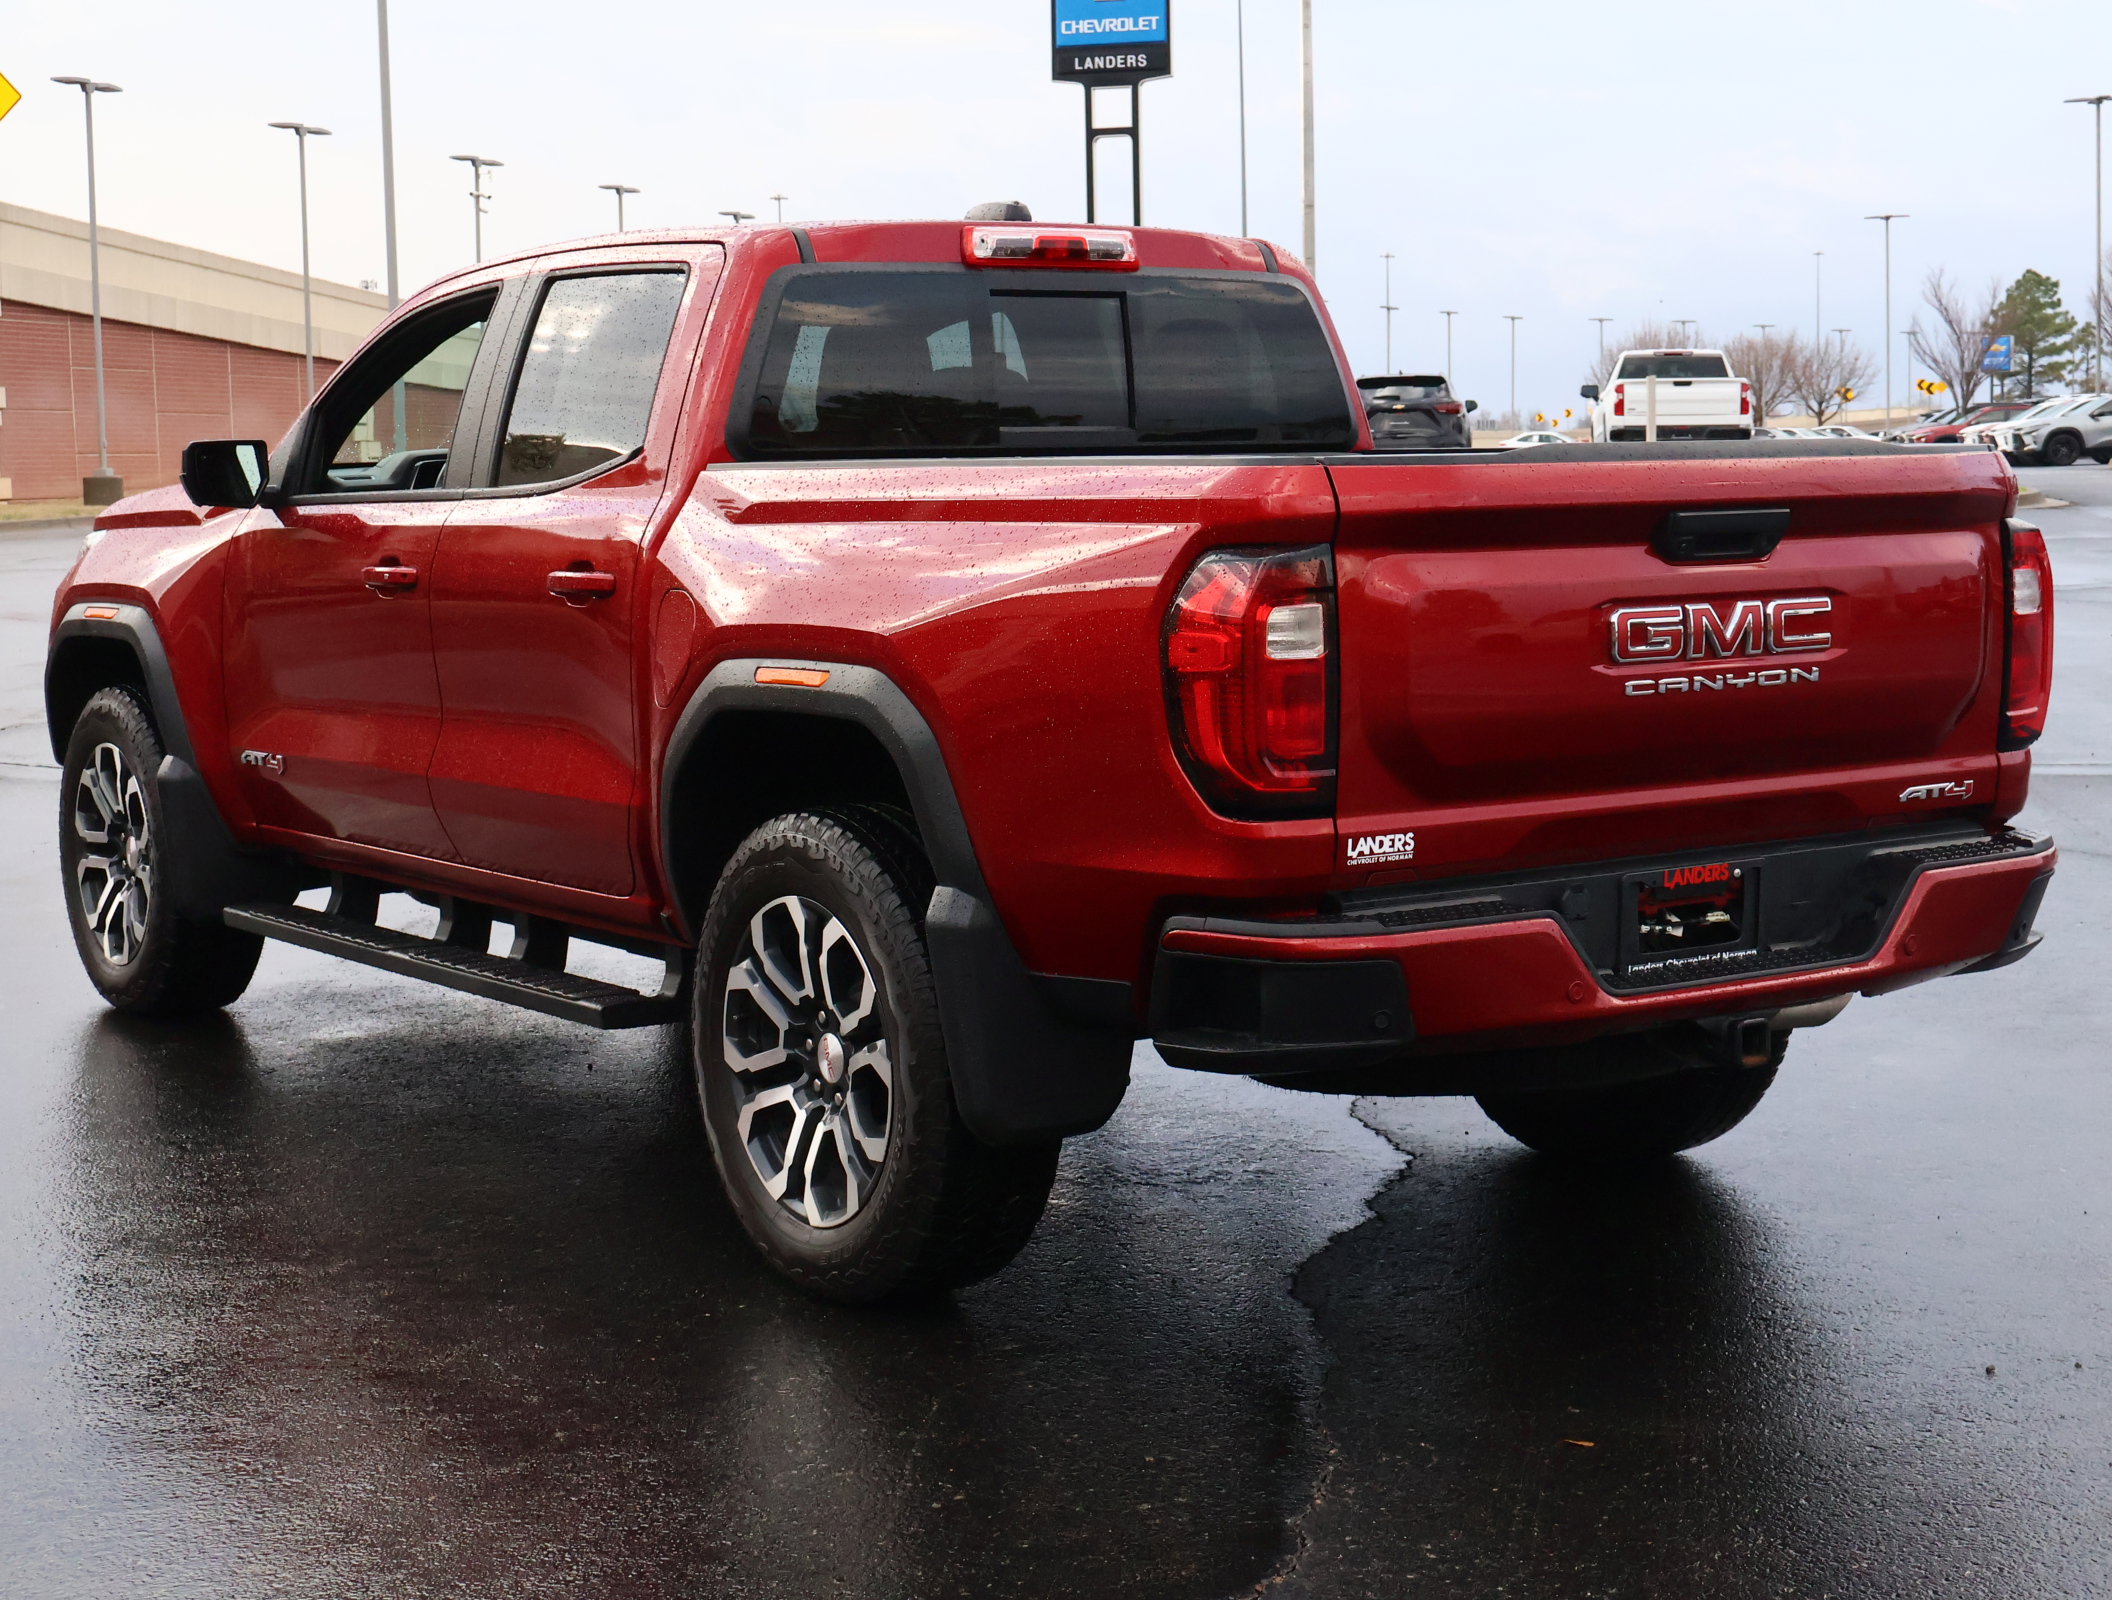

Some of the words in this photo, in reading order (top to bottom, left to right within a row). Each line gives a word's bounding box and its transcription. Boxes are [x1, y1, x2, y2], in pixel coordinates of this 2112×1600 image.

[1061, 16, 1159, 35] CHEVROLET
[1074, 54, 1148, 70] LANDERS
[1610, 597, 1832, 663] GMC
[1624, 666, 1820, 697] CANYON
[241, 750, 284, 775] AT4
[1899, 780, 1974, 802] AT4
[1347, 832, 1415, 858] LANDERS
[1347, 856, 1378, 866] CHEVROLET
[1379, 855, 1386, 863] OF
[1387, 853, 1413, 862] NORMAN
[1663, 863, 1730, 889] LANDERS
